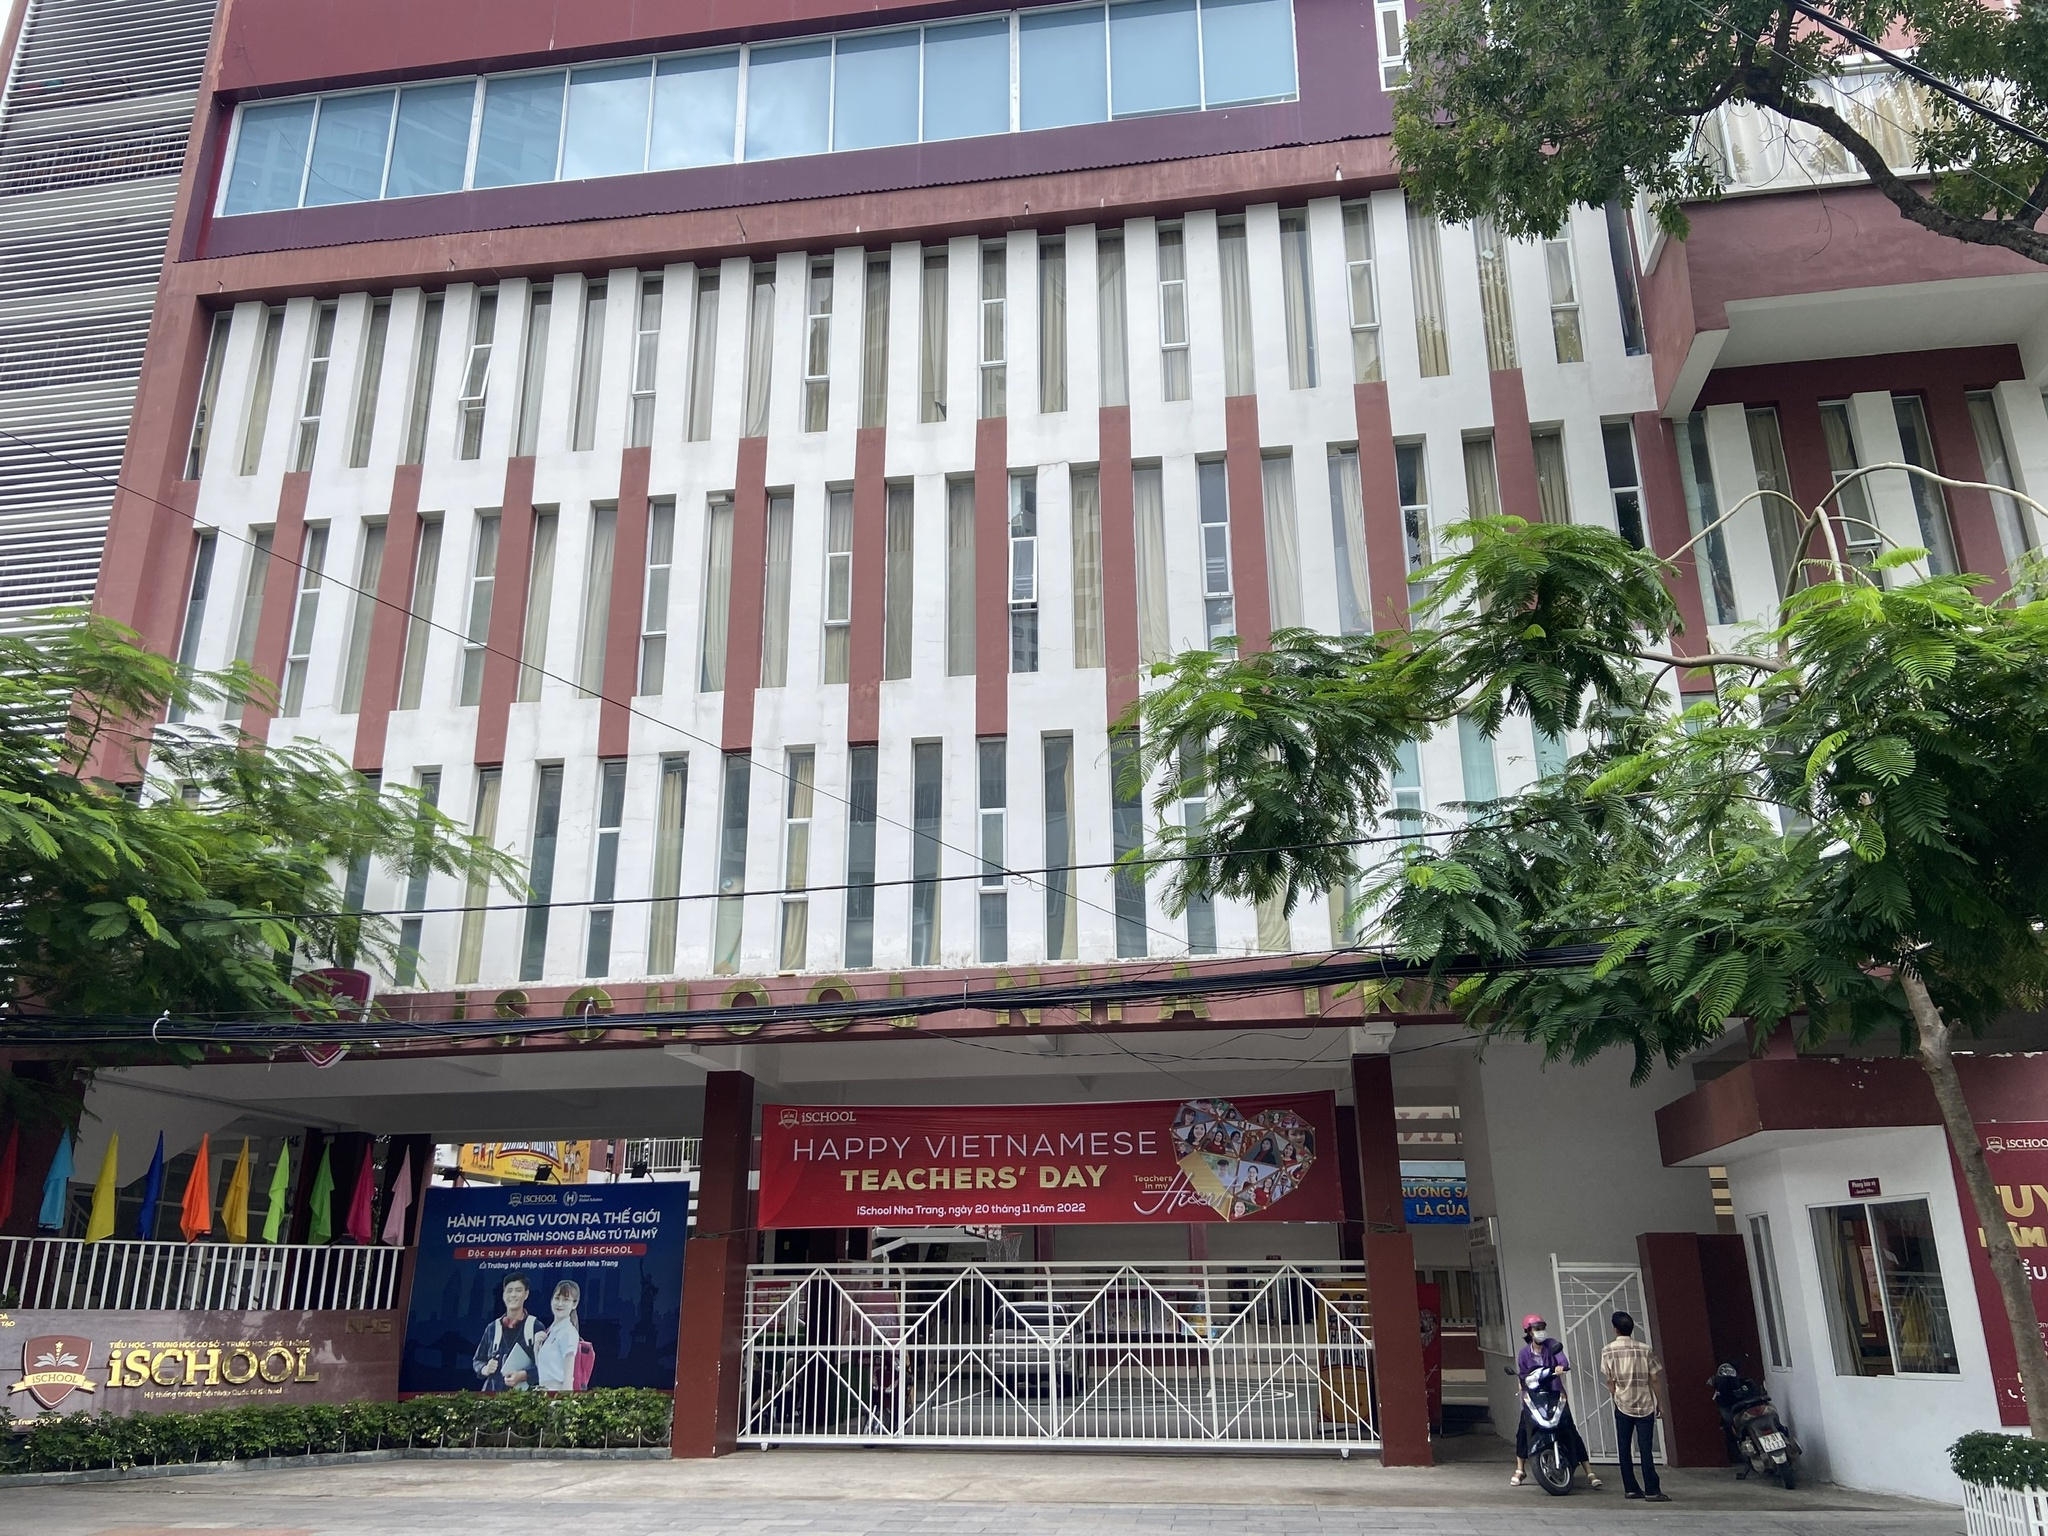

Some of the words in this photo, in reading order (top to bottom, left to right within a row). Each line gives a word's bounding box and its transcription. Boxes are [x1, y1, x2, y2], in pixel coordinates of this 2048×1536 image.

[801, 1111, 857, 1123] iSCHOOL
[793, 1136, 911, 1161] HAPPY
[925, 1131, 1157, 1159] VIETNAMESE
[840, 1166, 1027, 1191] TEACHERS'
[1039, 1164, 1108, 1188] DAY
[1134, 1174, 1173, 1182] Teachers
[523, 1194, 557, 1202] iSCHOOL
[857, 1206, 892, 1216] iSchool
[894, 1206, 914, 1215] Nha
[915, 1205, 947, 1217] Trang,
[949, 1204, 973, 1217] ngày
[975, 1204, 990, 1214] 20
[991, 1203, 1021, 1216] tháng
[1022, 1204, 1031, 1213] 11
[1033, 1203, 1055, 1213] năm
[1057, 1203, 1086, 1213] 2022
[1416, 1201, 1433, 1215] LÀ
[1436, 1199, 1467, 1215] CỦA
[447, 1213, 486, 1228] HÀNH
[489, 1213, 535, 1227] TRANG
[538, 1212, 579, 1226] VƯƠN
[581, 1212, 601, 1225] RA
[603, 1207, 632, 1224] THẾ
[632, 1208, 660, 1223] GIỚI
[447, 1232, 465, 1244] VỚI
[466, 1233, 512, 1243] CHƯƠNG
[513, 1230, 544, 1242] TRÌNH
[545, 1231, 575, 1242] SONG
[576, 1227, 606, 1241] BẰNG
[607, 1227, 621, 1240] TÚ
[623, 1227, 640, 1240] TÀI
[641, 1226, 658, 1239] MỸ
[467, 1249, 485, 1258] Độc
[519, 1248, 542, 1258] phát
[590, 1246, 633, 1254] iSCHOOL
[601, 1259, 619, 1268] Trang
[106, 1347, 320, 1387] iSCHOOL
[32, 1374, 79, 1384] iSCHOOL
